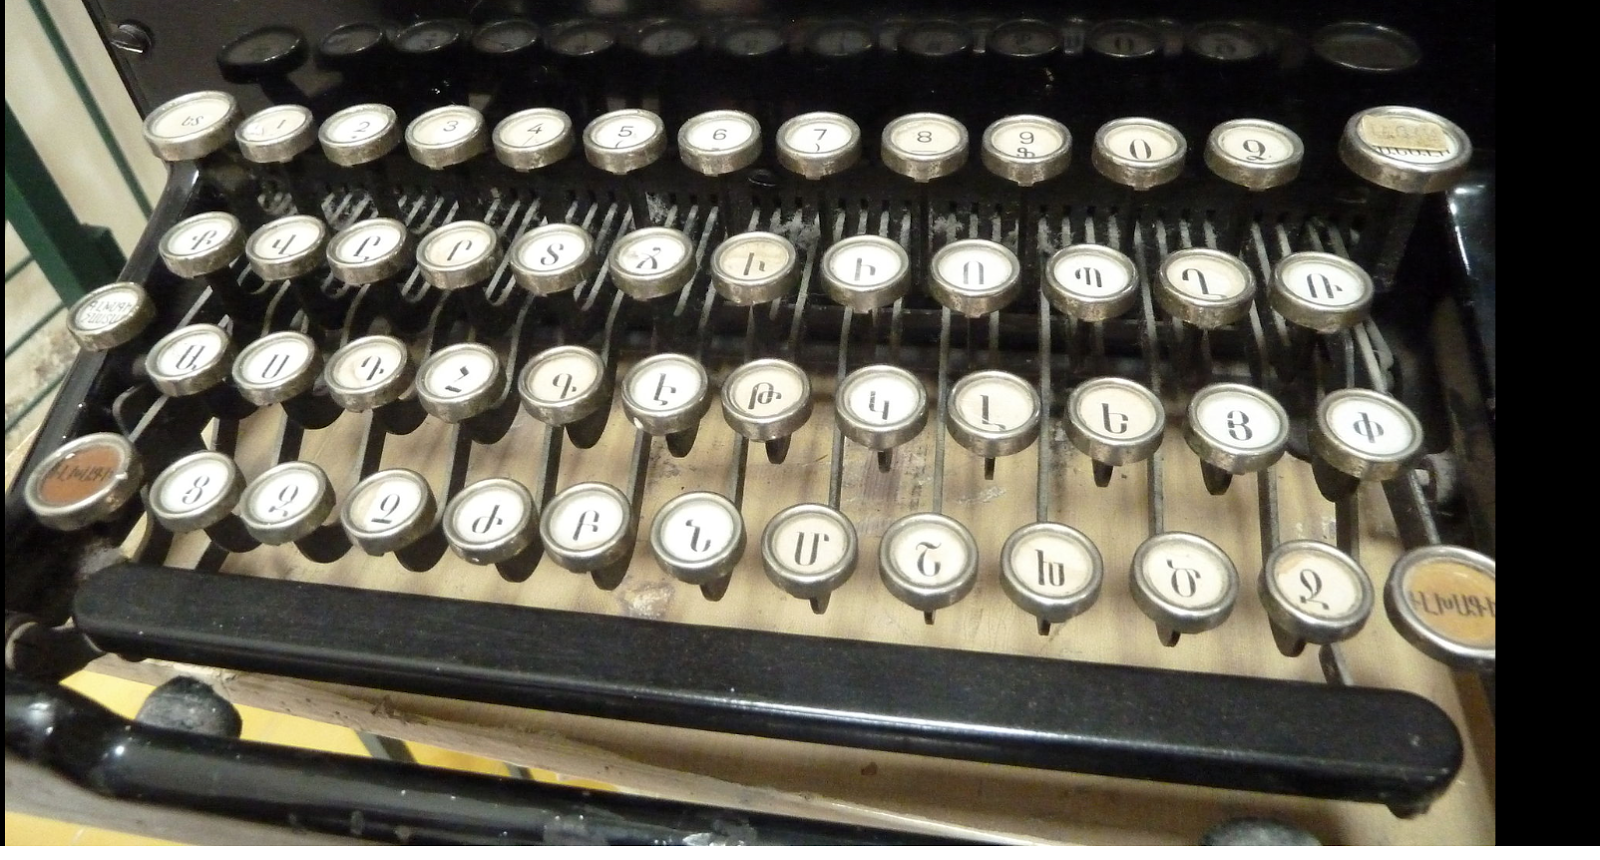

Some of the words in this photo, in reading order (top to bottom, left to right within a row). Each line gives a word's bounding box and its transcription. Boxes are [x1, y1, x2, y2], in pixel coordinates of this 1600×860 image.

[277, 119, 286, 129] 1
[354, 121, 370, 132] 2
[443, 120, 459, 132] 3
[527, 123, 544, 134] 4
[618, 126, 634, 137] 5
[712, 128, 727, 140] 6
[814, 128, 828, 140] 7
[917, 131, 932, 143] 8
[1019, 131, 1034, 145] 9
[447, 239, 473, 261] Ր
[540, 243, 564, 266] Տ
[963, 260, 985, 284] Ո
[1075, 267, 1103, 288] Պ
[261, 354, 290, 379] Ս
[445, 365, 470, 393] Հ
[552, 373, 577, 399] Գ
[654, 372, 677, 406] Է
[747, 382, 782, 410] Թ
[869, 390, 890, 420] Կ
[980, 394, 1007, 431] Լ
[1101, 403, 1129, 434] Ե
[1353, 411, 1385, 444] Փ
[472, 504, 503, 534] Ժ
[572, 510, 600, 541] Բ
[685, 519, 711, 553] Ն
[794, 531, 830, 566] Մ
[915, 541, 942, 577] Շ
[1034, 549, 1066, 586] Խ
[1166, 559, 1201, 598] Ծ
